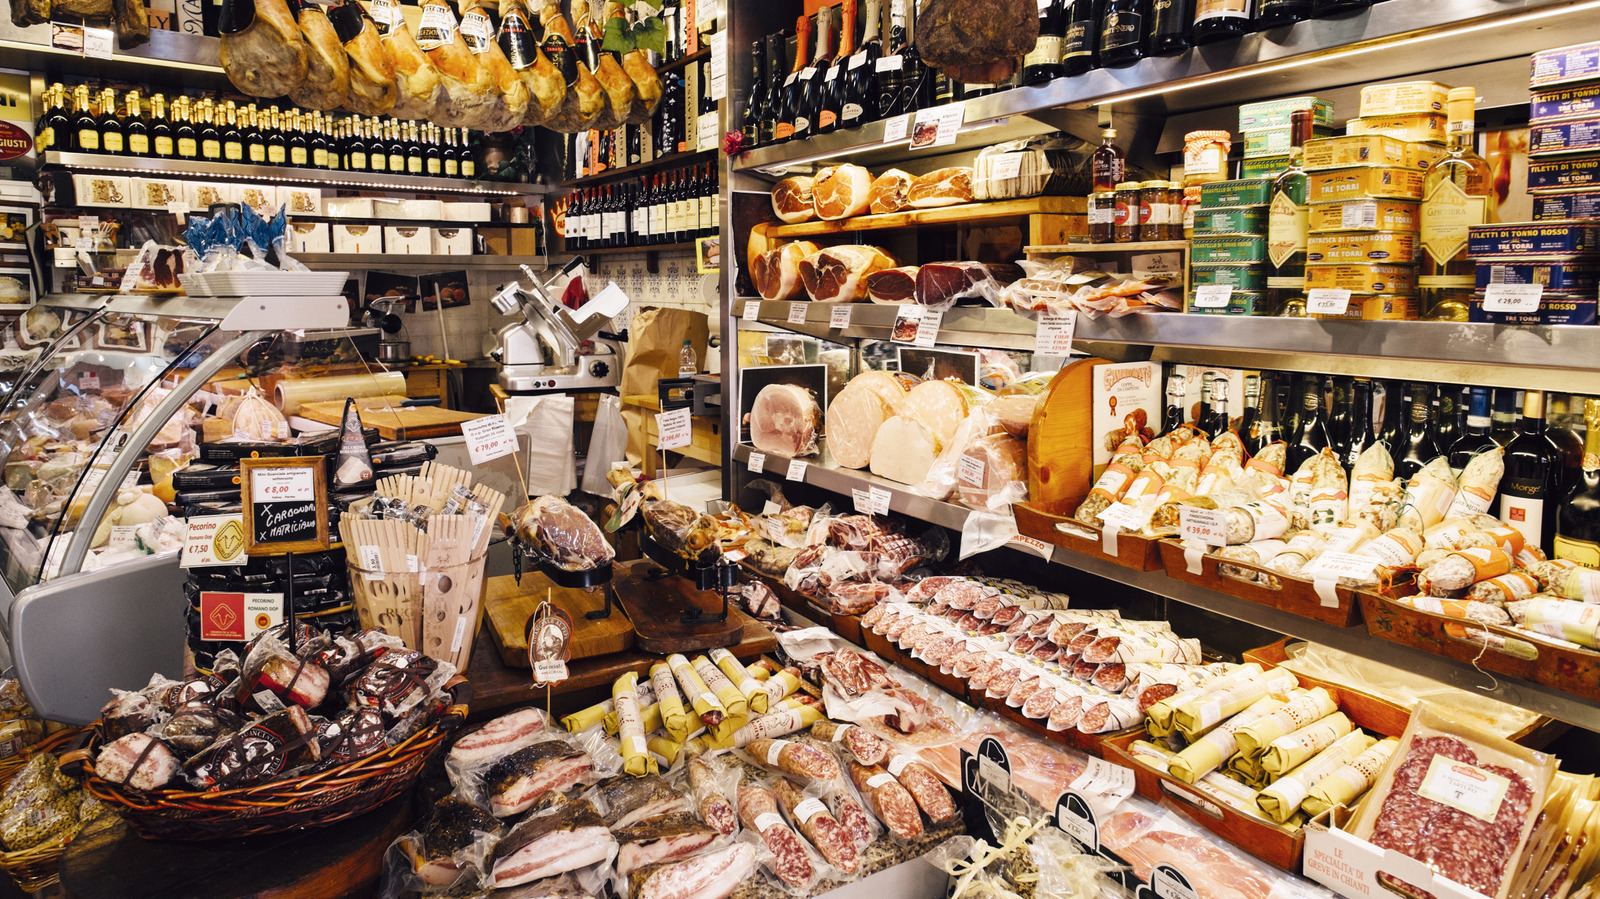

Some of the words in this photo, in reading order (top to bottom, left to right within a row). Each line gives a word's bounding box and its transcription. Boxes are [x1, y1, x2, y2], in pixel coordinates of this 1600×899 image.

[1336, 183, 1360, 192] TORRI
[189, 521, 217, 531] Pecorino
[1192, 526, 1210, 535] 39,00
[189, 545, 194, 553] €
[194, 544, 208, 554] 7,50
[1454, 790, 1464, 799] T
[1334, 848, 1343, 859] LE
[1308, 858, 1331, 876] GREVE
[1332, 869, 1339, 880] IN
[1340, 874, 1370, 896] CHIANTI
[1356, 869, 1364, 880] DI
